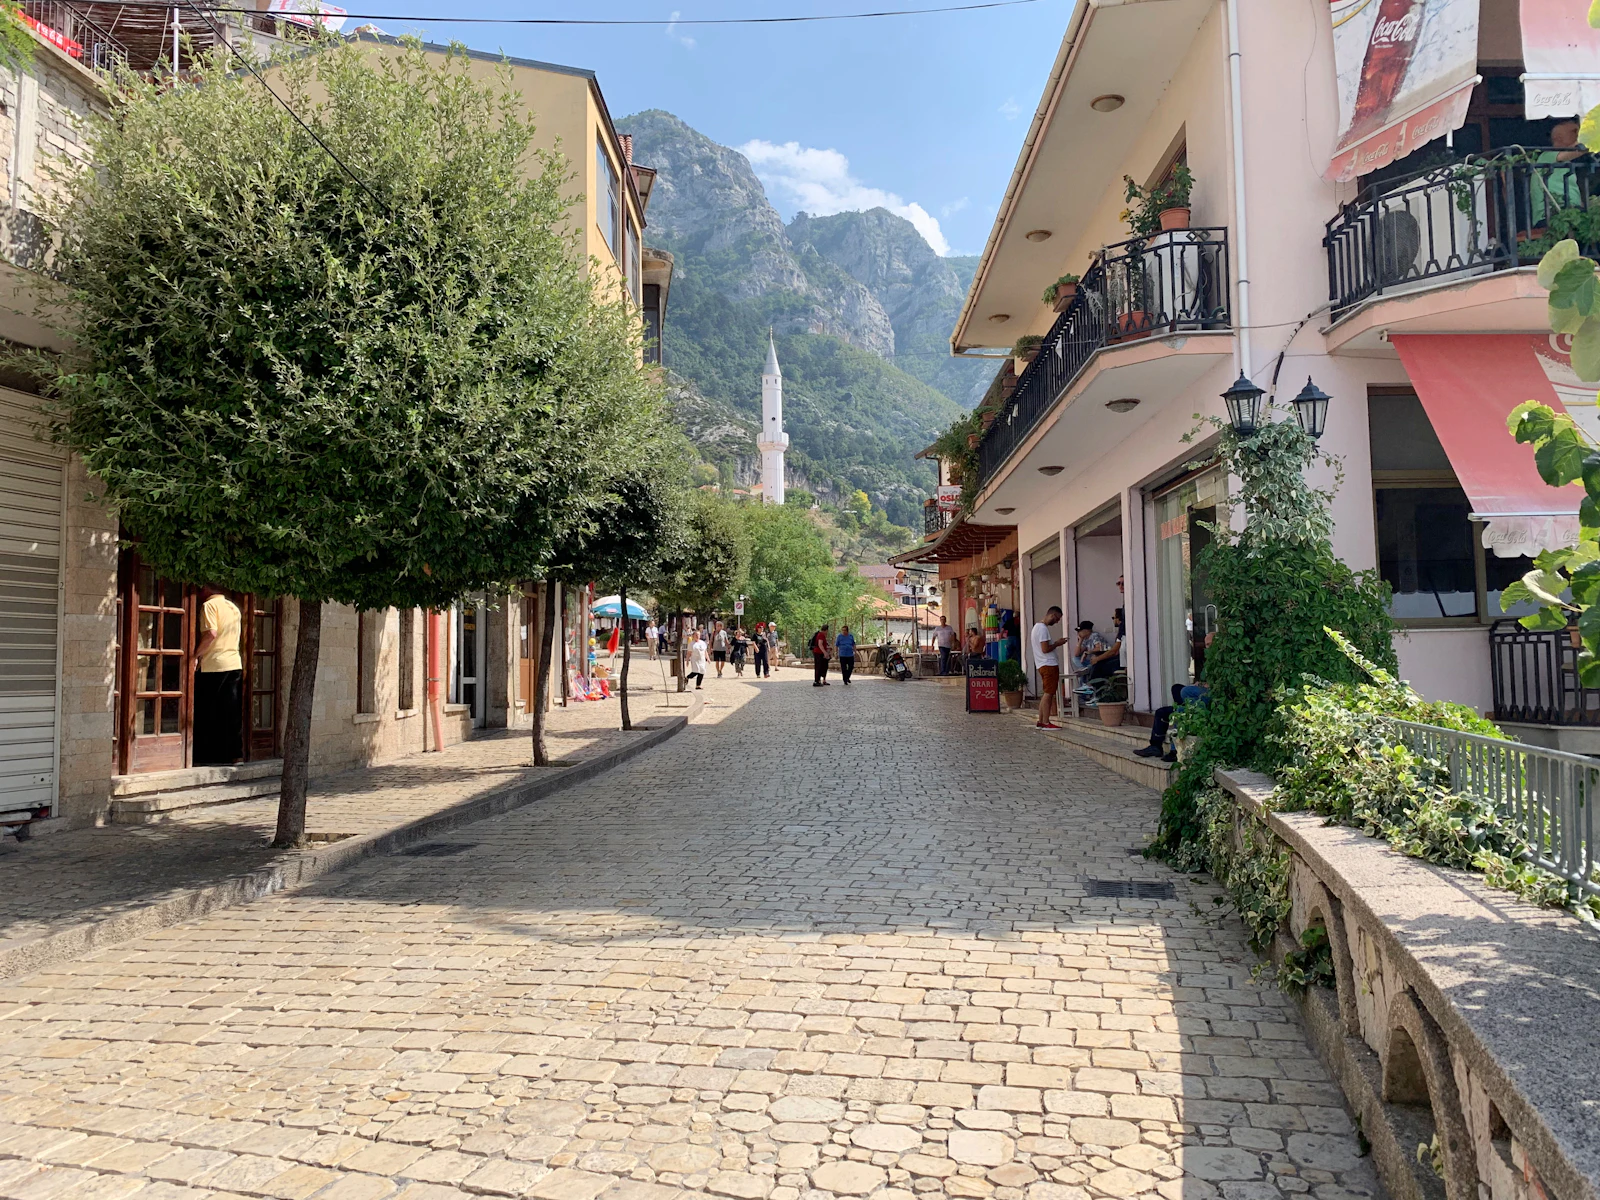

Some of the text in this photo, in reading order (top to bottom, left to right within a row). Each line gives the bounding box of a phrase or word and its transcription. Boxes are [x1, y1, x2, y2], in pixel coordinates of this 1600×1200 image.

[1371, 13, 1420, 45] Coca-Cola
[1533, 92, 1571, 107] Coca-Cola
[1412, 117, 1440, 140] Coca-Cola
[1363, 142, 1390, 164] Coca-Cola
[1488, 529, 1528, 545] Coca-Cola
[968, 664, 997, 678] Restorant
[975, 690, 996, 699] 7-22
